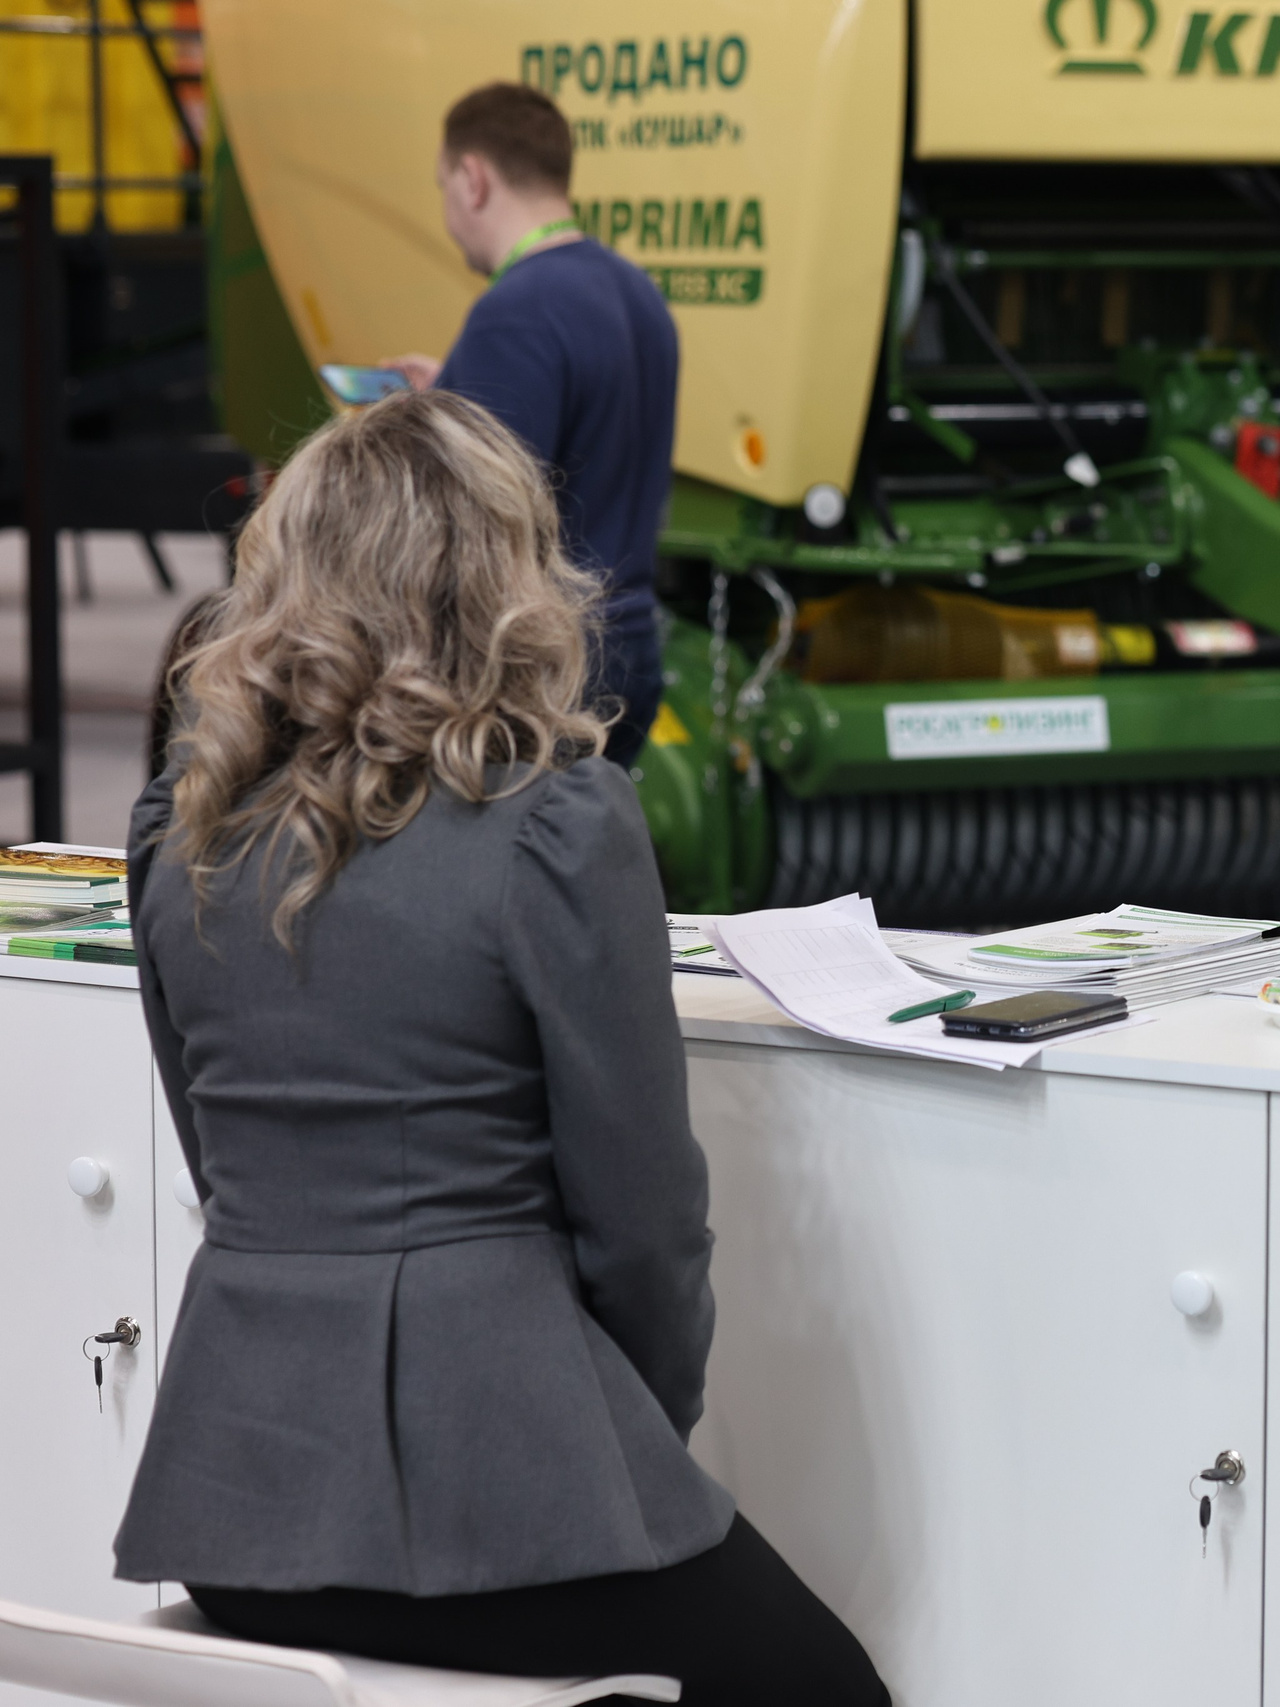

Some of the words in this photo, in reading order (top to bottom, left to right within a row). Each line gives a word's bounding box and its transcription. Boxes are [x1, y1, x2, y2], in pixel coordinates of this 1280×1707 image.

[520, 34, 749, 101] ПРОДАНО
[571, 117, 605, 149] ПК
[573, 196, 765, 250] MPRIMA
